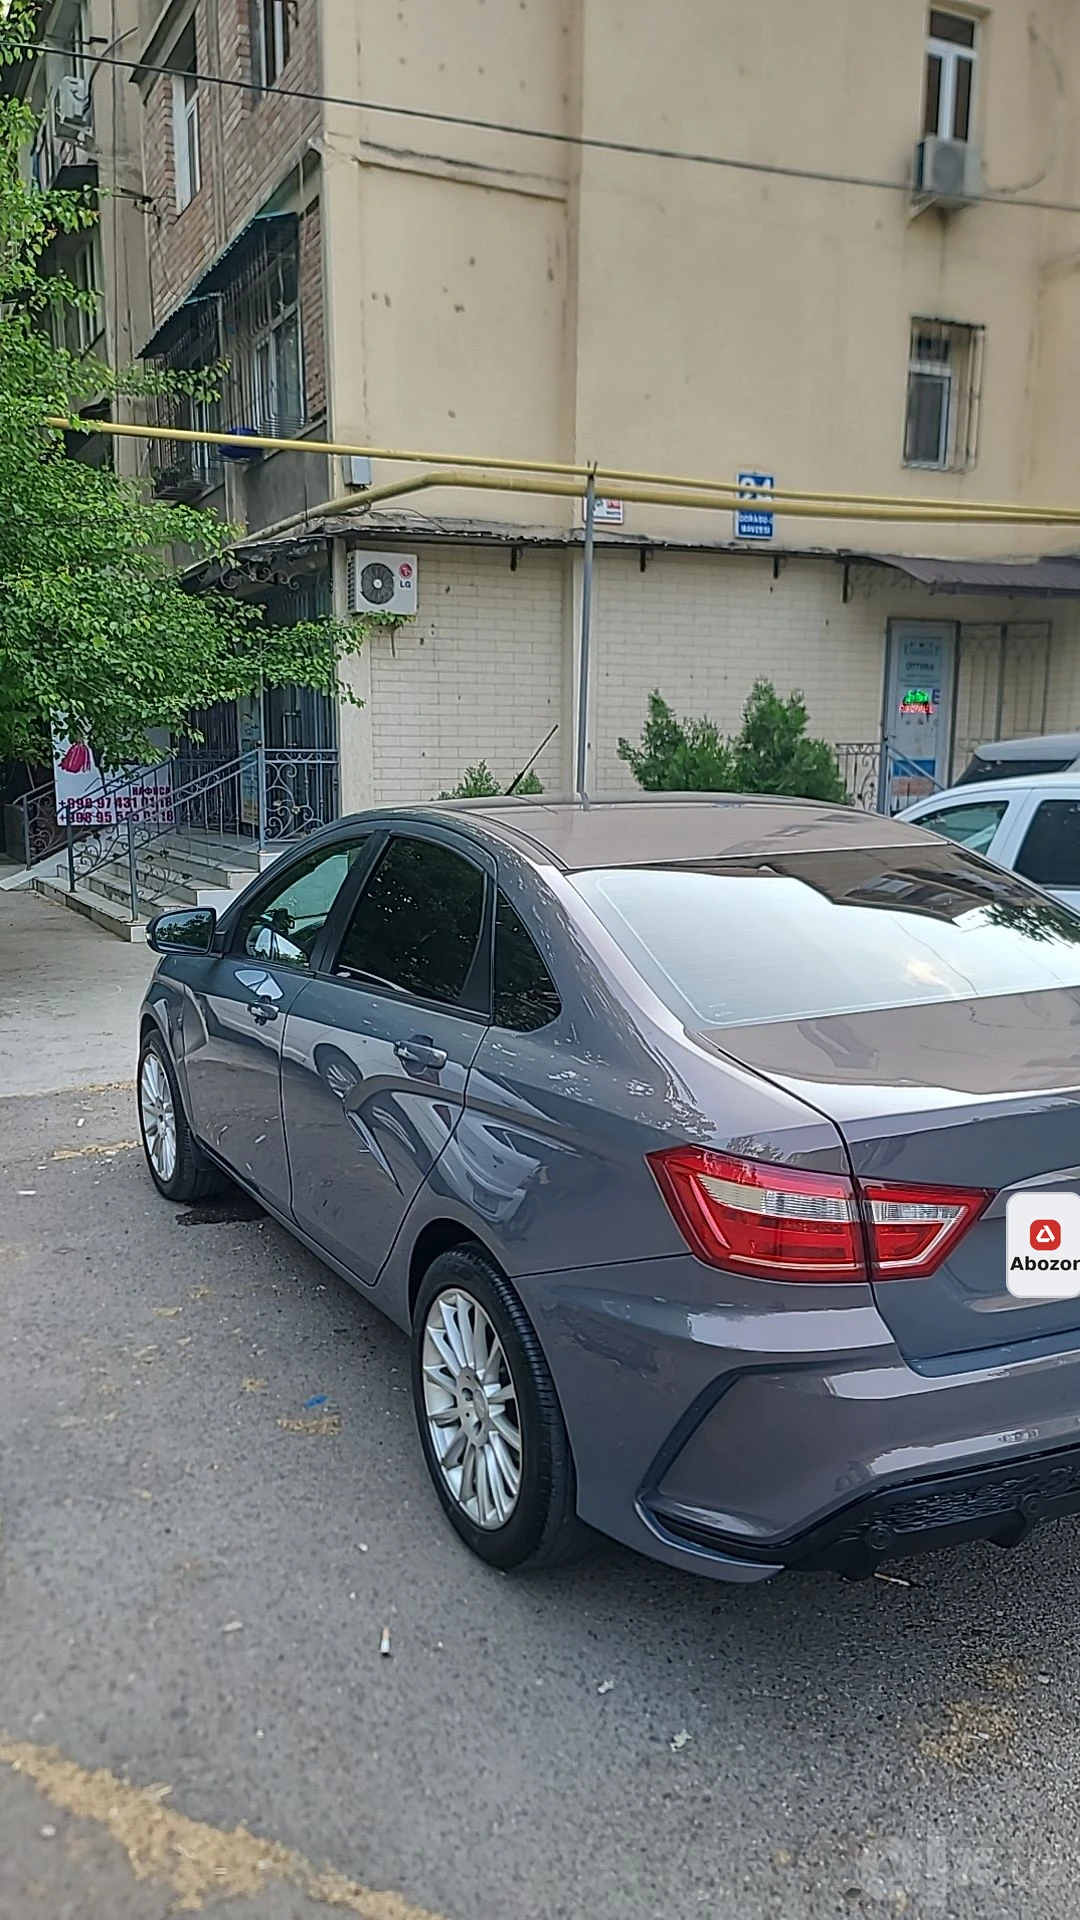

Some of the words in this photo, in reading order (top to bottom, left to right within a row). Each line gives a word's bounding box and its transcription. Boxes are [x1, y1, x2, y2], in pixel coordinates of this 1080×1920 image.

[400, 580, 411, 588] LG
[132, 787, 171, 796] НАФИСА
[97, 797, 111, 809] 97
[96, 811, 112, 823] 95
